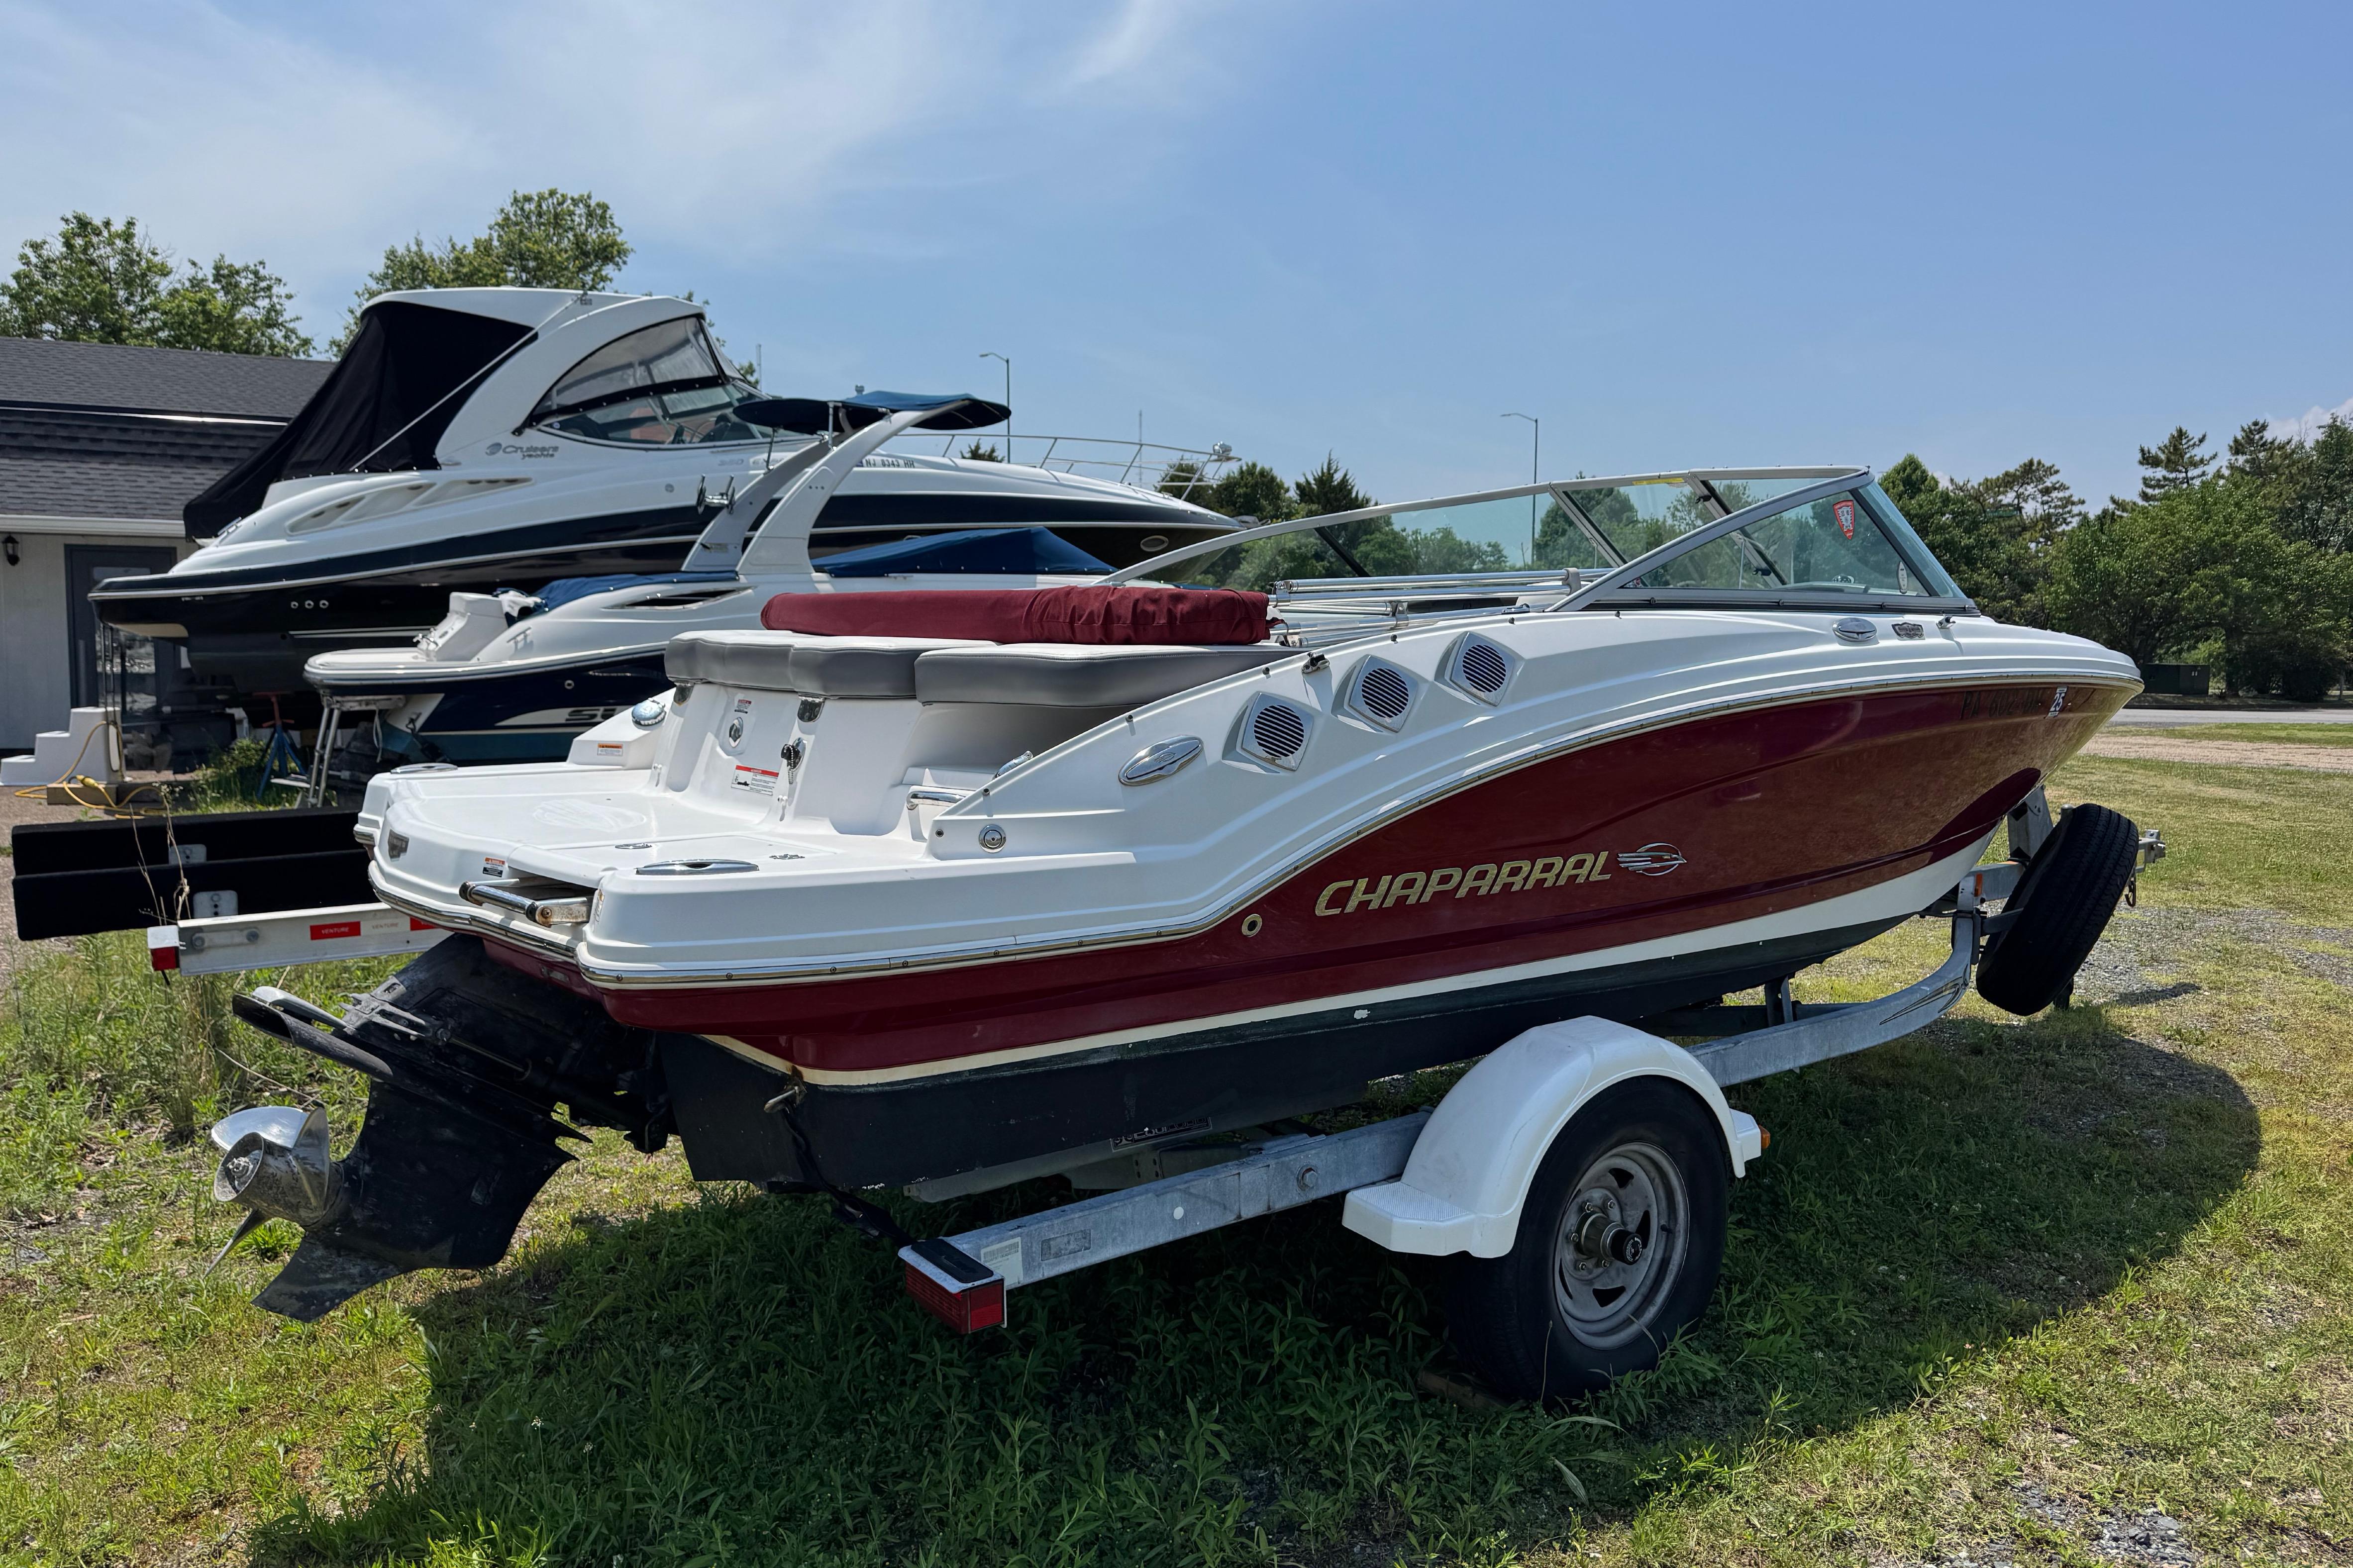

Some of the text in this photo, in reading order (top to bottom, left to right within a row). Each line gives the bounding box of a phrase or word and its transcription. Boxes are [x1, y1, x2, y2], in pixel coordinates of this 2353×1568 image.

[866, 458, 876, 467] NJ
[2050, 693, 2065, 711] 25
[1315, 851, 1611, 916] CHAPARRAL
